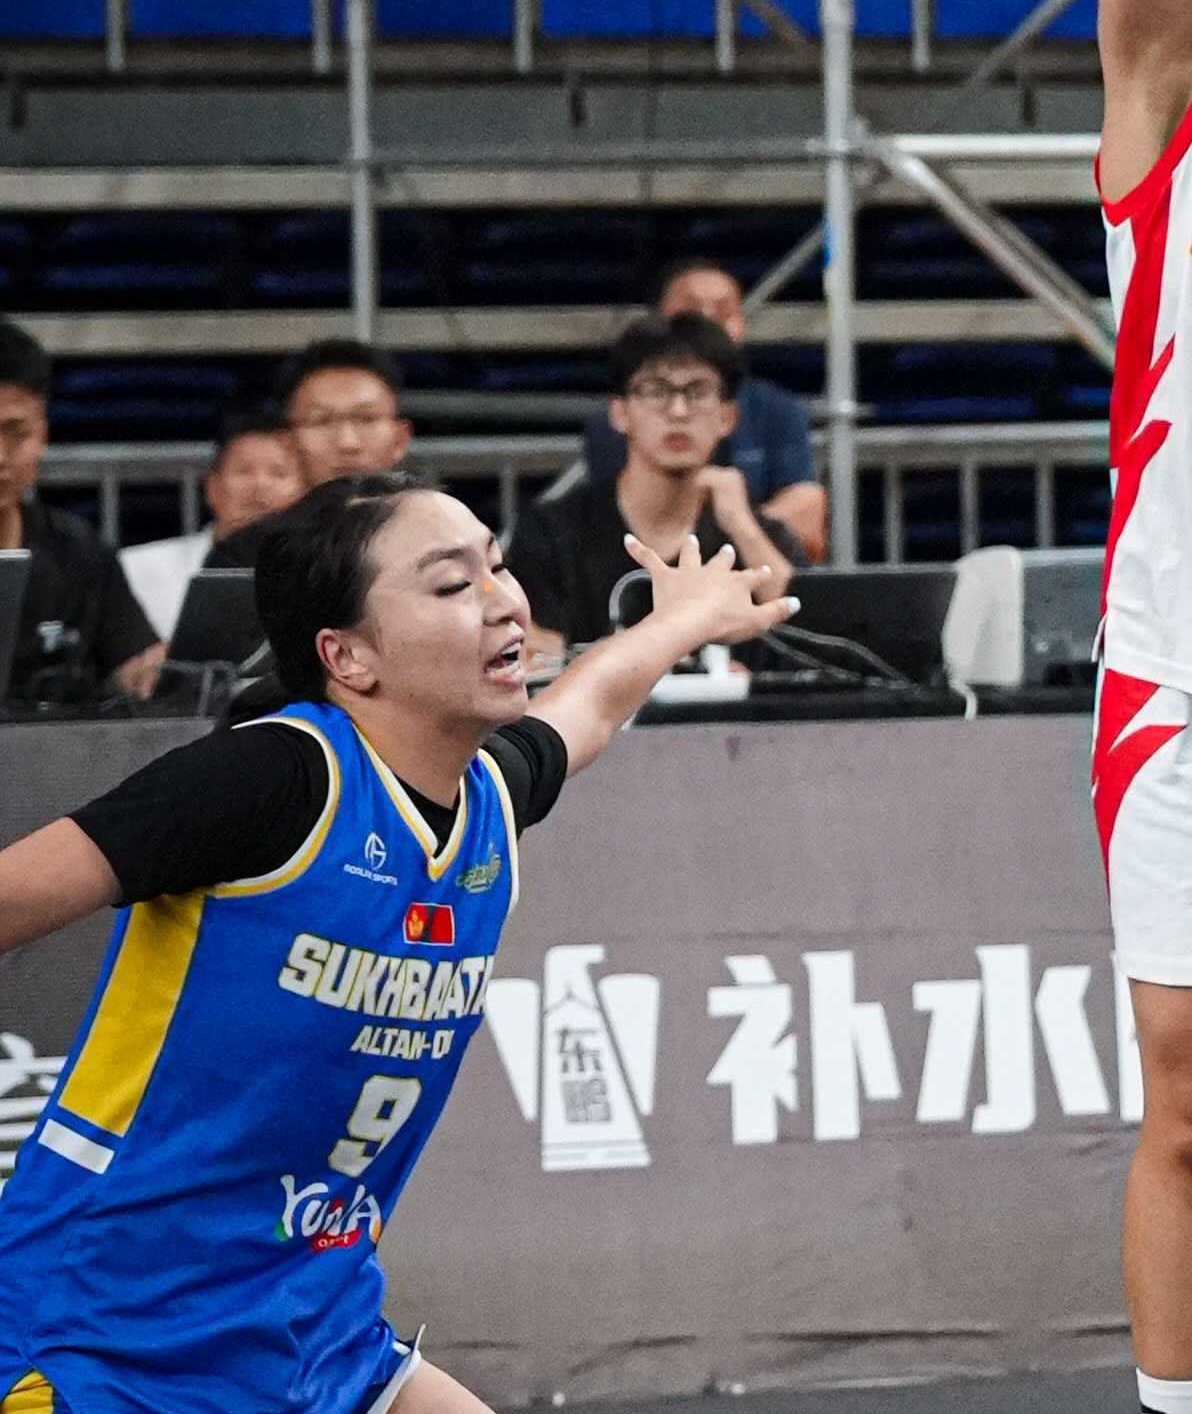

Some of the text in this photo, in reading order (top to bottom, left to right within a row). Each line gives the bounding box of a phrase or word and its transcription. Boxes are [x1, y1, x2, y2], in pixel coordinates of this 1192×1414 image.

[278, 932, 494, 1021] SUKHBAATA
[350, 1024, 455, 1060] ALTAN-O
[327, 1074, 422, 1178] 9
